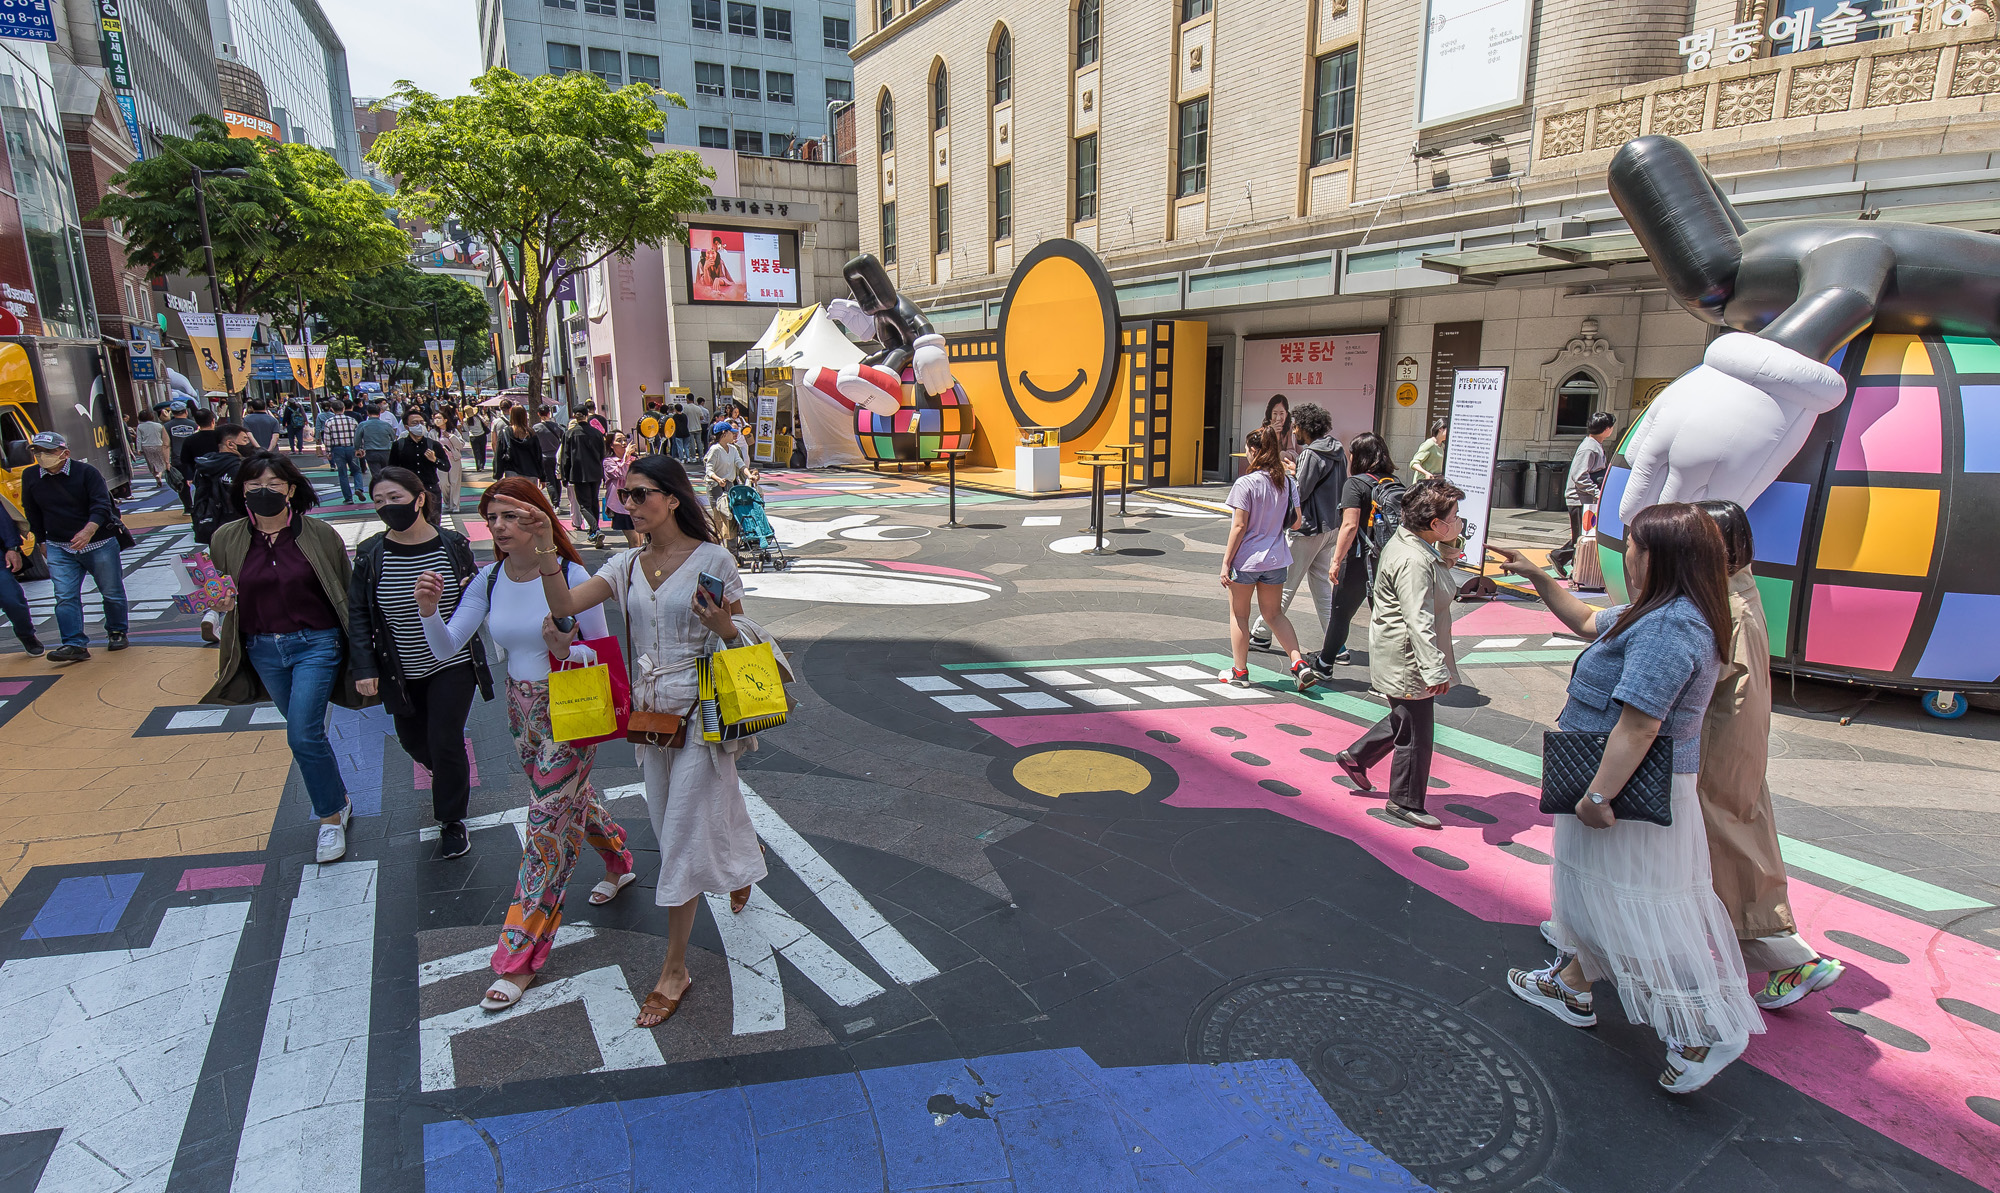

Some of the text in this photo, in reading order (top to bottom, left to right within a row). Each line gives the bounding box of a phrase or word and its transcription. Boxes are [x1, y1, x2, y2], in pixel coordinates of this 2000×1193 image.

[18, 12, 49, 26] 8-gil
[103, 20, 121, 30] 치과
[108, 32, 127, 85] 연세미소래
[225, 112, 273, 135] 라거의 반전
[706, 198, 789, 217] 명동예술극장
[751, 258, 770, 274] 벚꽃
[1280, 342, 1306, 363] 벚꽃
[1308, 340, 1336, 362] 동산
[616, 706, 626, 716] RY
